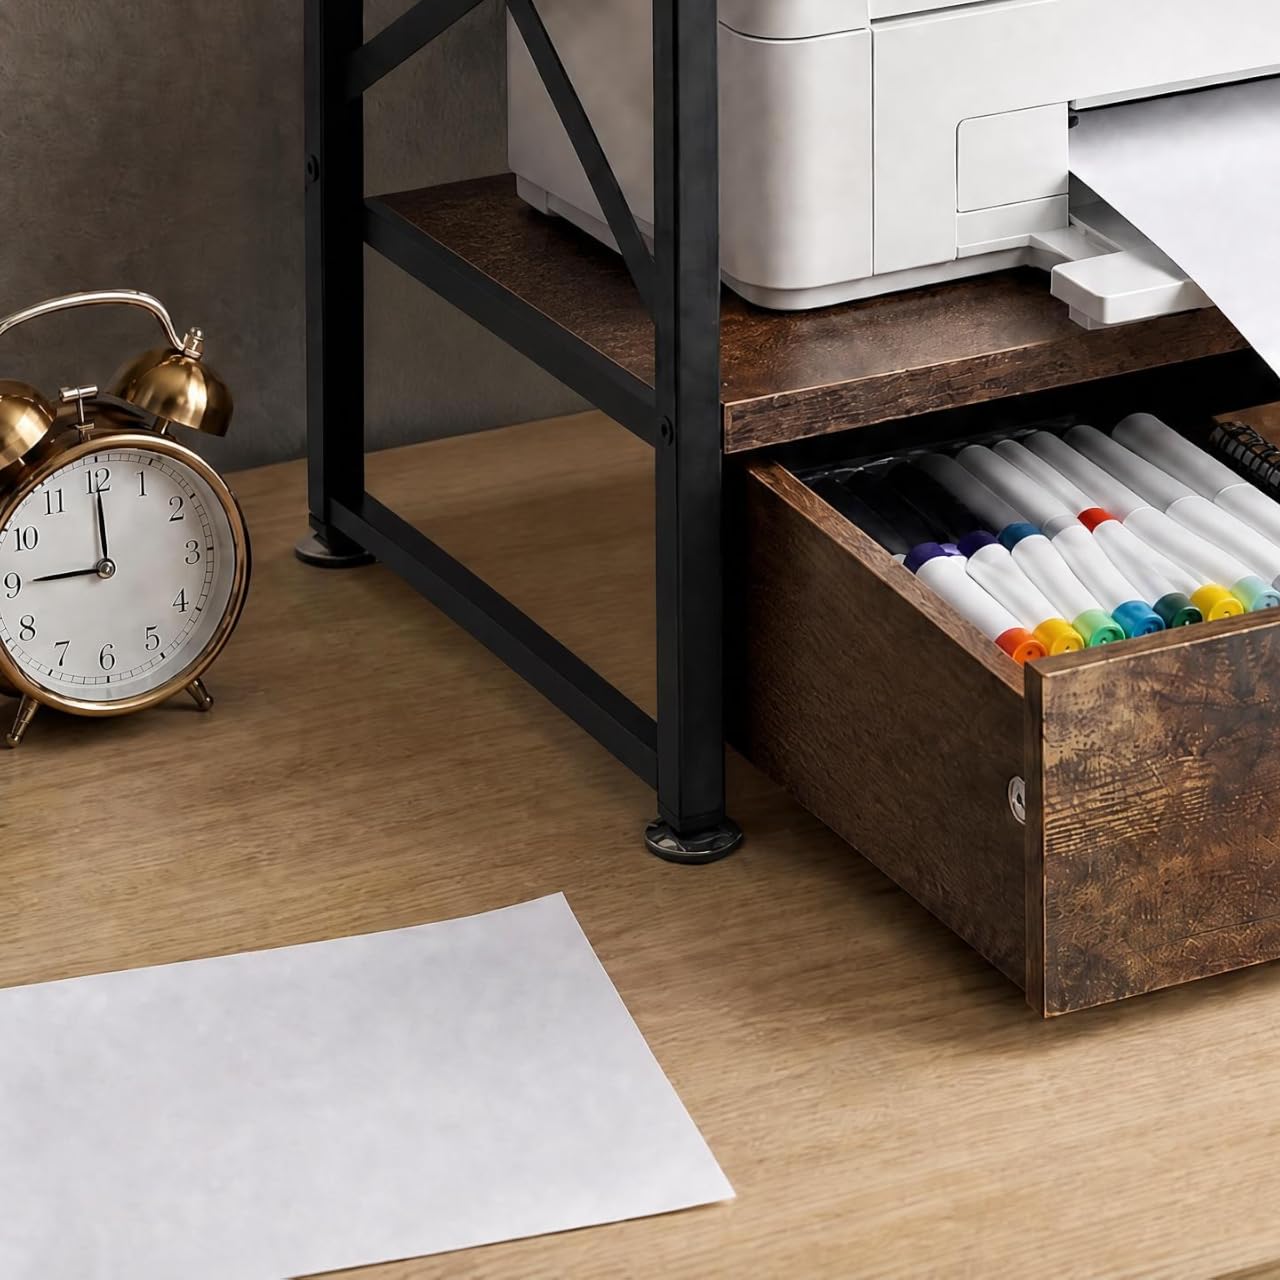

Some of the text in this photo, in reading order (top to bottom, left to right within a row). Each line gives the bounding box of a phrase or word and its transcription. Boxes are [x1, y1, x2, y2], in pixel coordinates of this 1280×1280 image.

[85, 468, 111, 494] 12
[137, 471, 148, 497] 1
[43, 488, 66, 516] 11
[168, 496, 184, 522] 2
[14, 526, 39, 552] 10
[184, 540, 201, 565] 3
[4, 572, 21, 599] 9
[172, 588, 189, 613] 4
[19, 615, 36, 641] 8
[145, 625, 160, 651] 5
[54, 640, 70, 666] 7
[99, 643, 116, 670] 6
